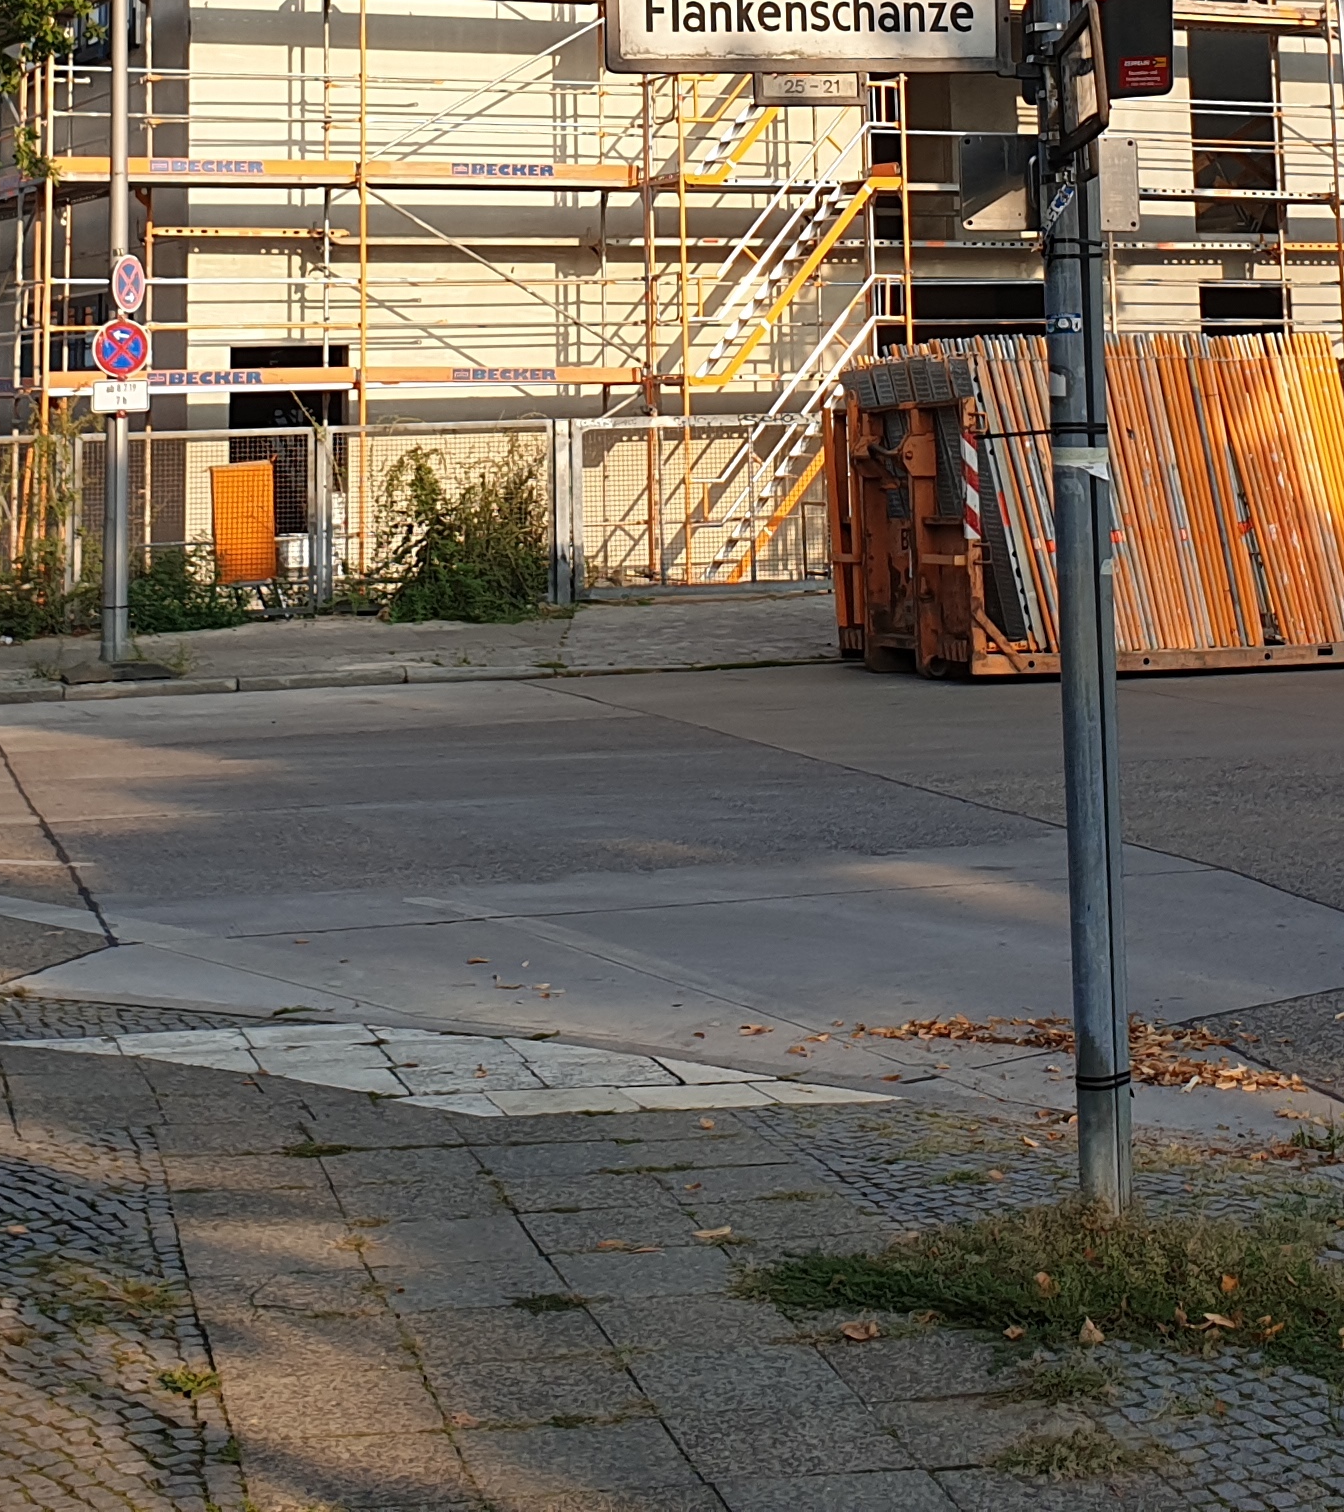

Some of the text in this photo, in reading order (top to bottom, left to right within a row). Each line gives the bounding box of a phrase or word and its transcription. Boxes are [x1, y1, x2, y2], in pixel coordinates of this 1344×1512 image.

[784, 79, 806, 94] 25
[823, 79, 841, 94] 21
[172, 160, 263, 173] BECKER
[471, 163, 554, 176] BECKER
[169, 371, 263, 385] BECKER
[472, 368, 557, 380] BECKER
